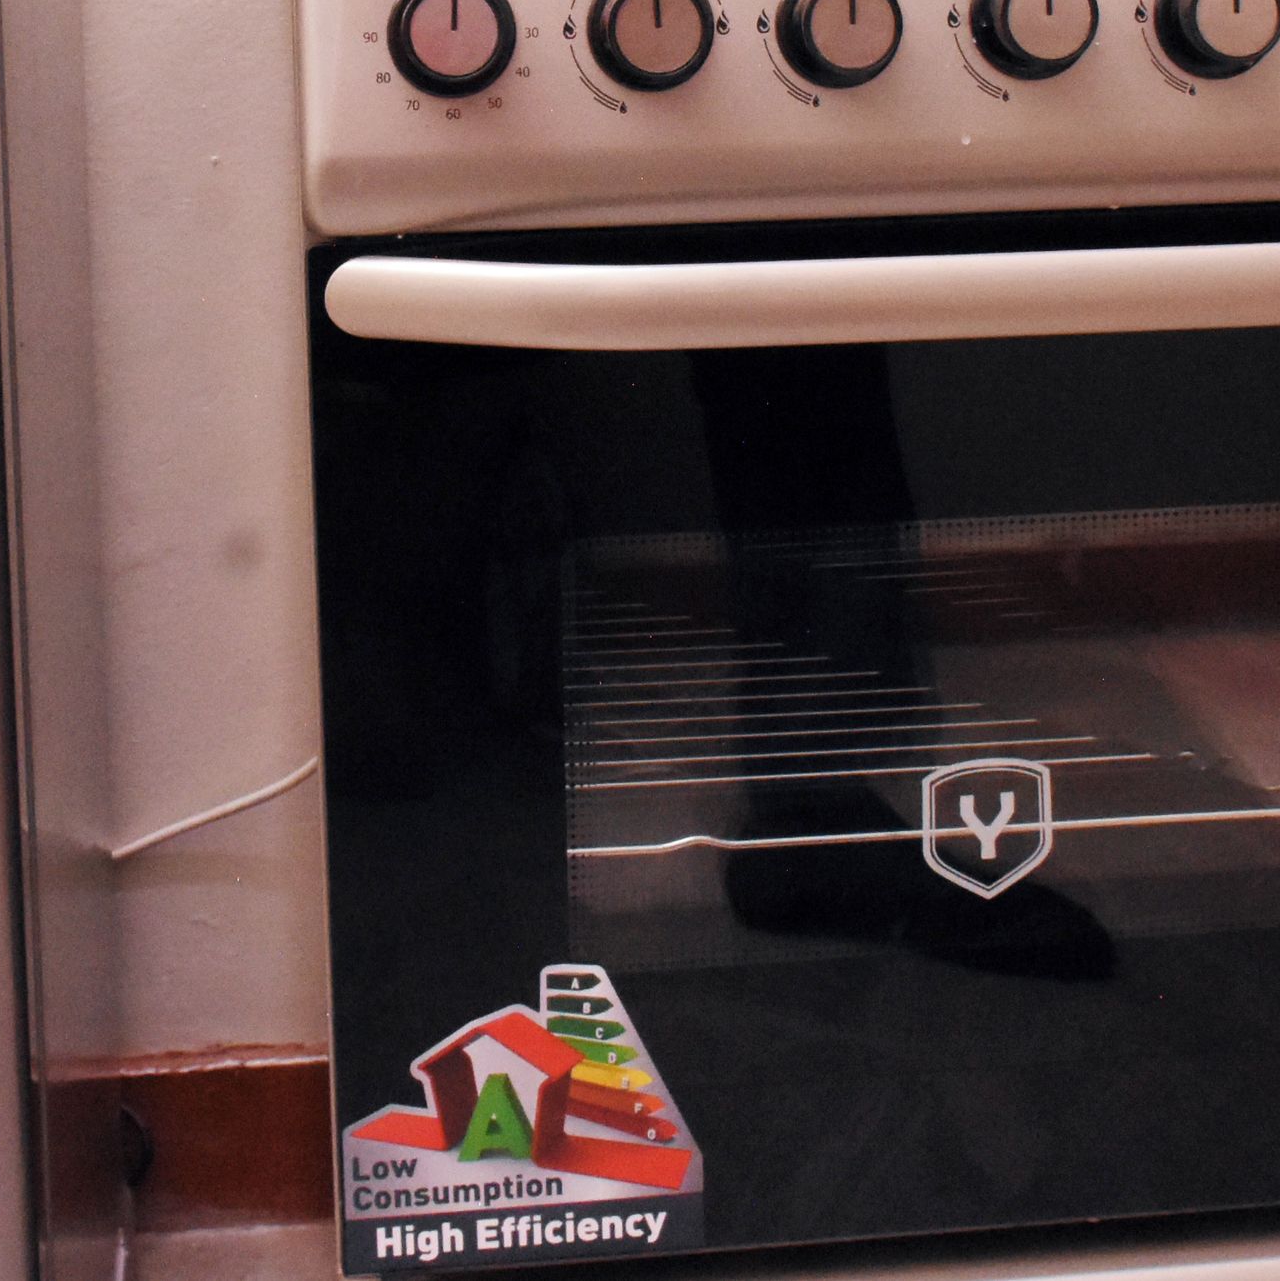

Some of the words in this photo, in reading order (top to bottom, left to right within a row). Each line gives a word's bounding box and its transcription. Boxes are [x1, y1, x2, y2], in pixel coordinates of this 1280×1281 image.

[363, 32, 378, 43] 90
[524, 27, 539, 39] 30
[376, 72, 391, 84] 80
[515, 66, 530, 78] 40
[406, 99, 420, 111] 70
[488, 97, 503, 109] 50
[445, 108, 461, 120] 60
[570, 977, 580, 990] A
[582, 1002, 591, 1014] B
[595, 1027, 604, 1039] C
[607, 1052, 617, 1063] D
[634, 1102, 644, 1114] F
[458, 1073, 536, 1162] A
[352, 1156, 418, 1182] Low
[352, 1174, 563, 1211] Consumption
[376, 1221, 465, 1261] High
[476, 1211, 667, 1251] Efficiency
